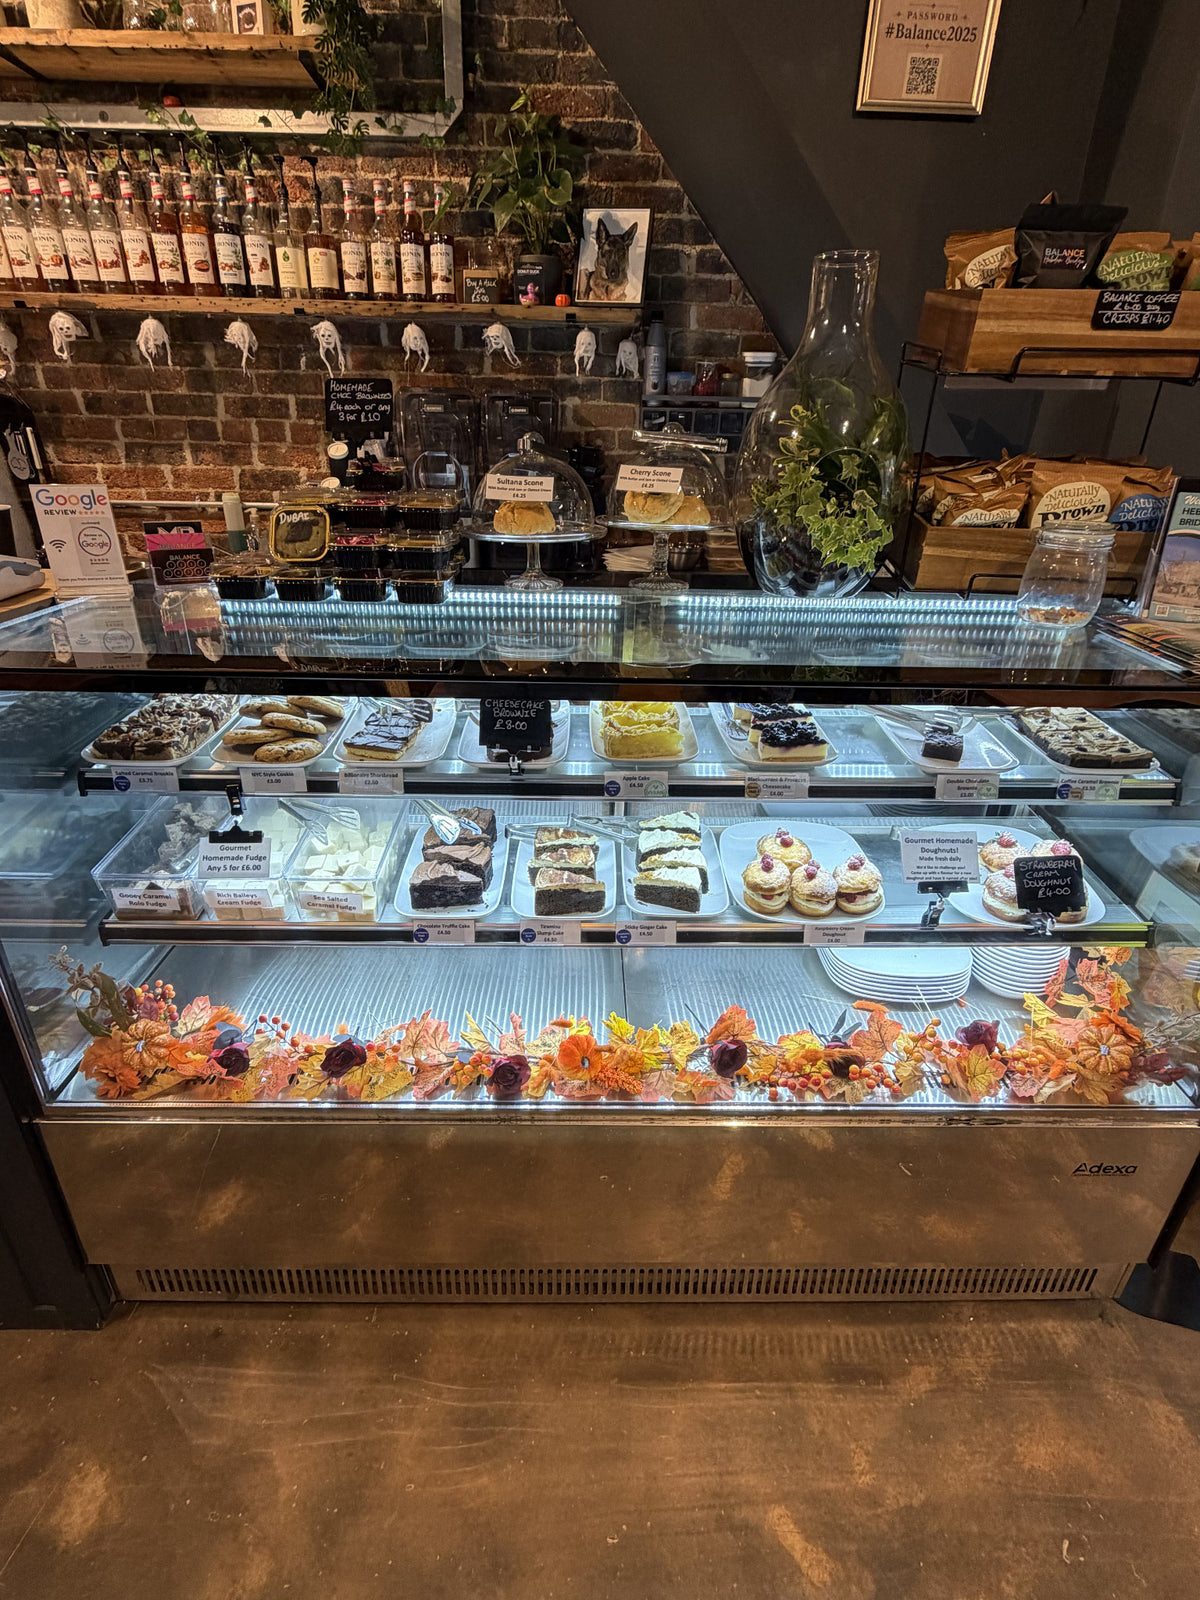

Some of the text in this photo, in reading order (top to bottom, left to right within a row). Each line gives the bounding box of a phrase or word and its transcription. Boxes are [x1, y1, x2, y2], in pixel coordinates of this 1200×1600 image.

[907, 11, 958, 22] PASSWORD
[885, 22, 978, 43] #Balance2025
[1046, 248, 1085, 258] BALANCE
[1102, 292, 1181, 304] BALANCE COFFEE
[1103, 312, 1140, 324] CRISPS
[330, 380, 375, 392] HOMEMADE
[330, 392, 392, 400] CHOC BROWNIES
[344, 403, 362, 411] each
[364, 403, 376, 411] or
[378, 404, 391, 415] any
[338, 412, 381, 423] 3 for £10
[630, 468, 652, 477] Cherry
[497, 478, 523, 486] Sultana
[36, 489, 108, 510] Google
[82, 540, 109, 549] Google
[485, 699, 545, 710] CHEESECAKE
[493, 707, 537, 718] BROWNIE
[494, 719, 528, 730] £8.00
[904, 837, 974, 845] Gourmet Homemade
[920, 847, 959, 855] Doughnuts!
[1019, 859, 1078, 871] STRAWBERRY
[1025, 870, 1060, 879] CREAM
[1023, 877, 1072, 888] DOUGHNUT
[1038, 887, 1071, 898] £4.00
[1072, 1163, 1138, 1174] Adexa
